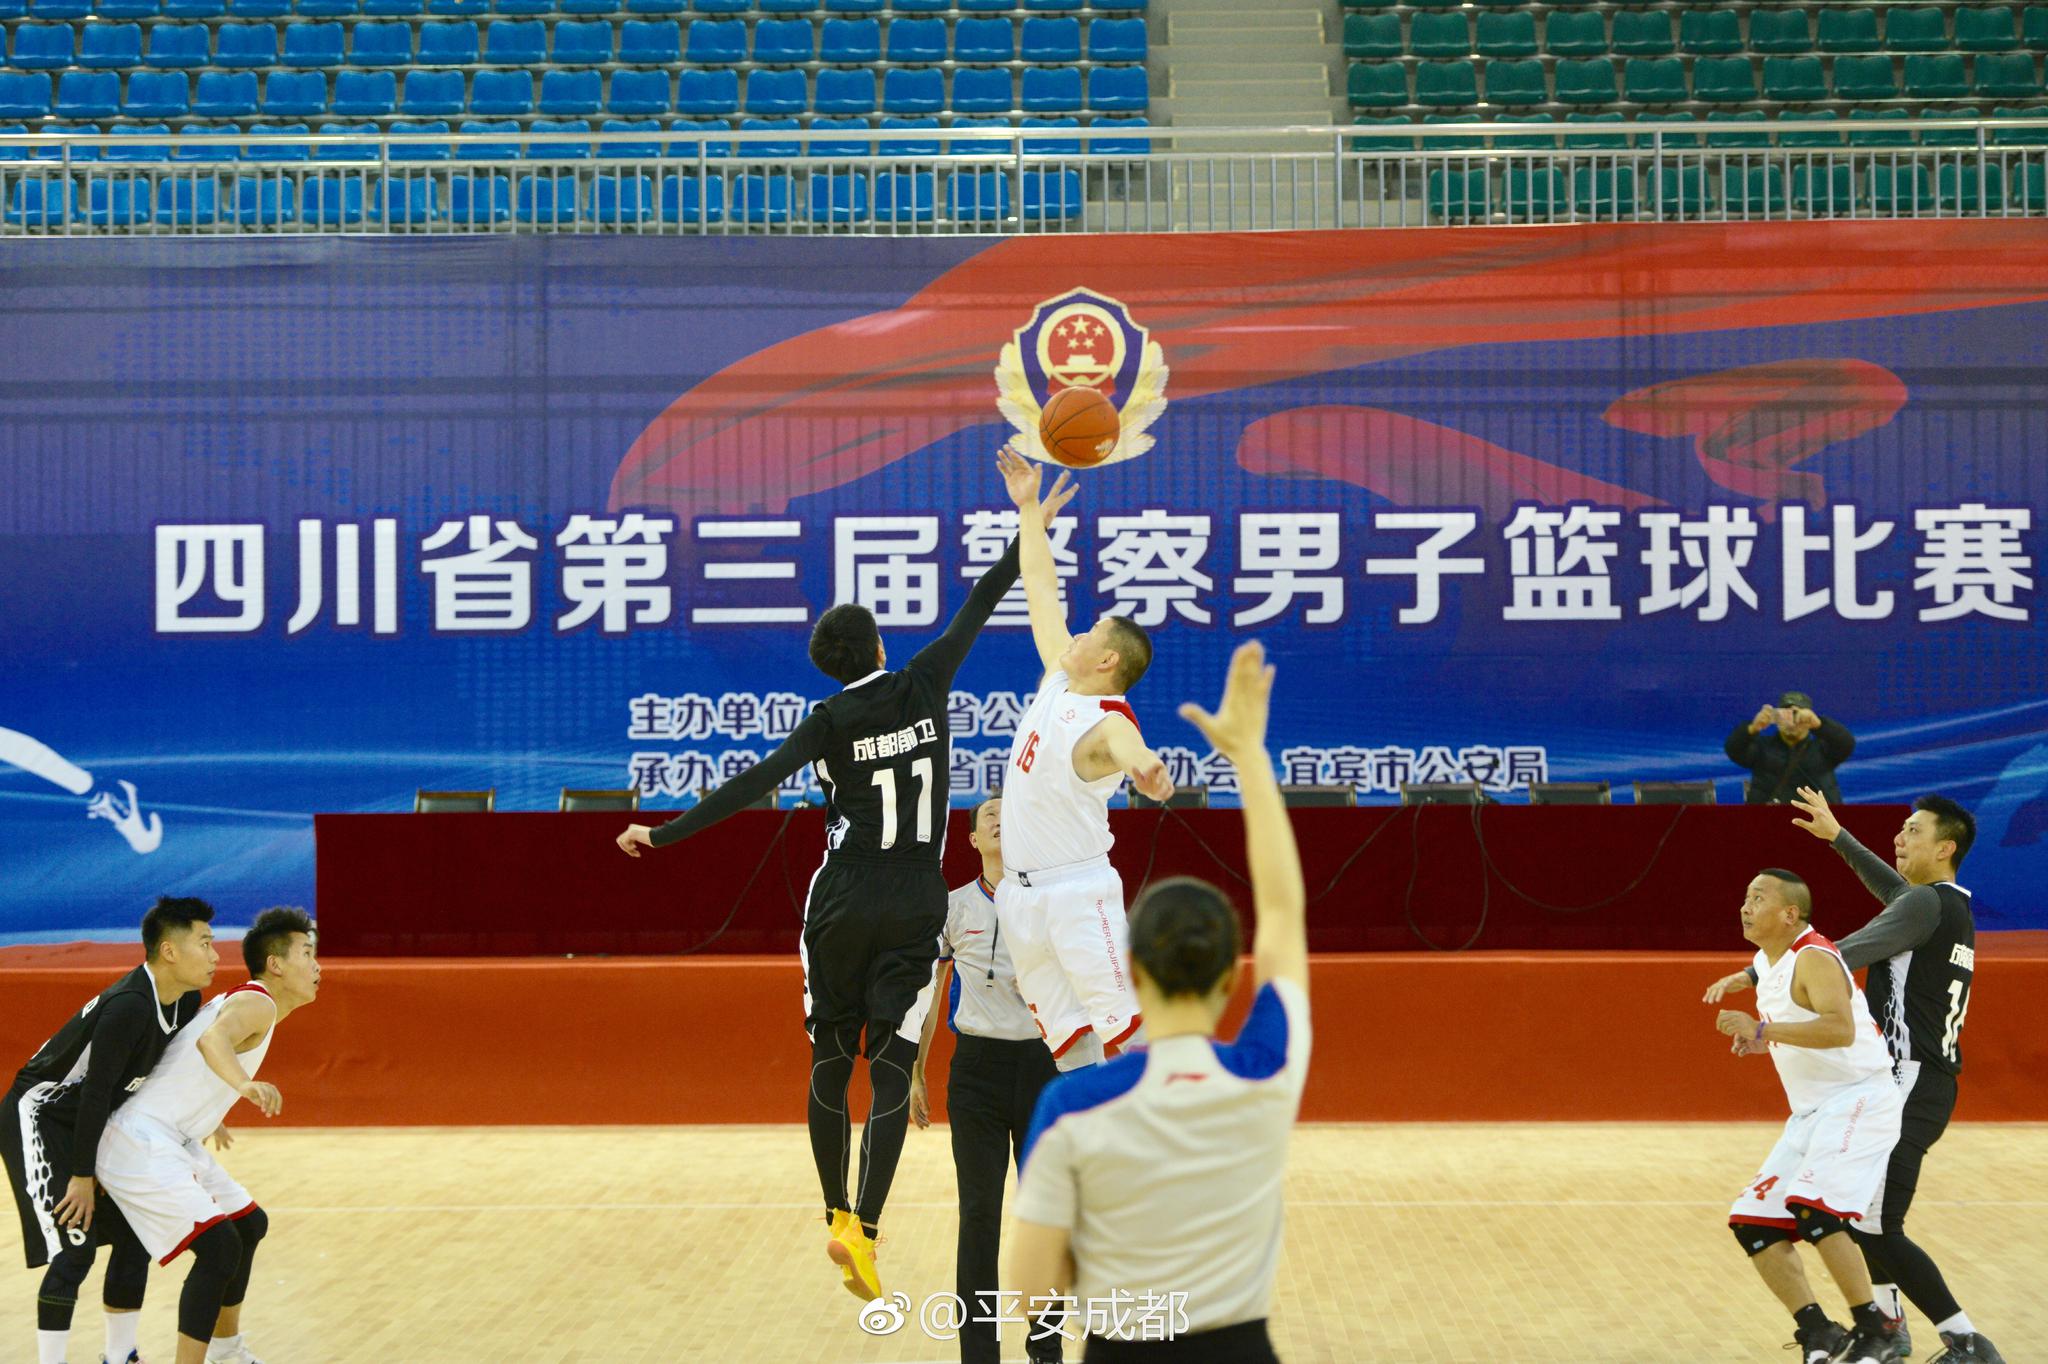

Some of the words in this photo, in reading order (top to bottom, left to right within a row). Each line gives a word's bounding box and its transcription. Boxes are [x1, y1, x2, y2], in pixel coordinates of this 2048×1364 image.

[155, 503, 2033, 635] 四川省第三届警察男子篮球比赛
[629, 694, 804, 739] 主办单位
[947, 690, 1034, 736] 省公
[853, 718, 938, 762] 成都前卫
[1016, 730, 1040, 774] 16
[1283, 747, 1546, 790] 宜宾市公安局
[871, 757, 933, 850] 11
